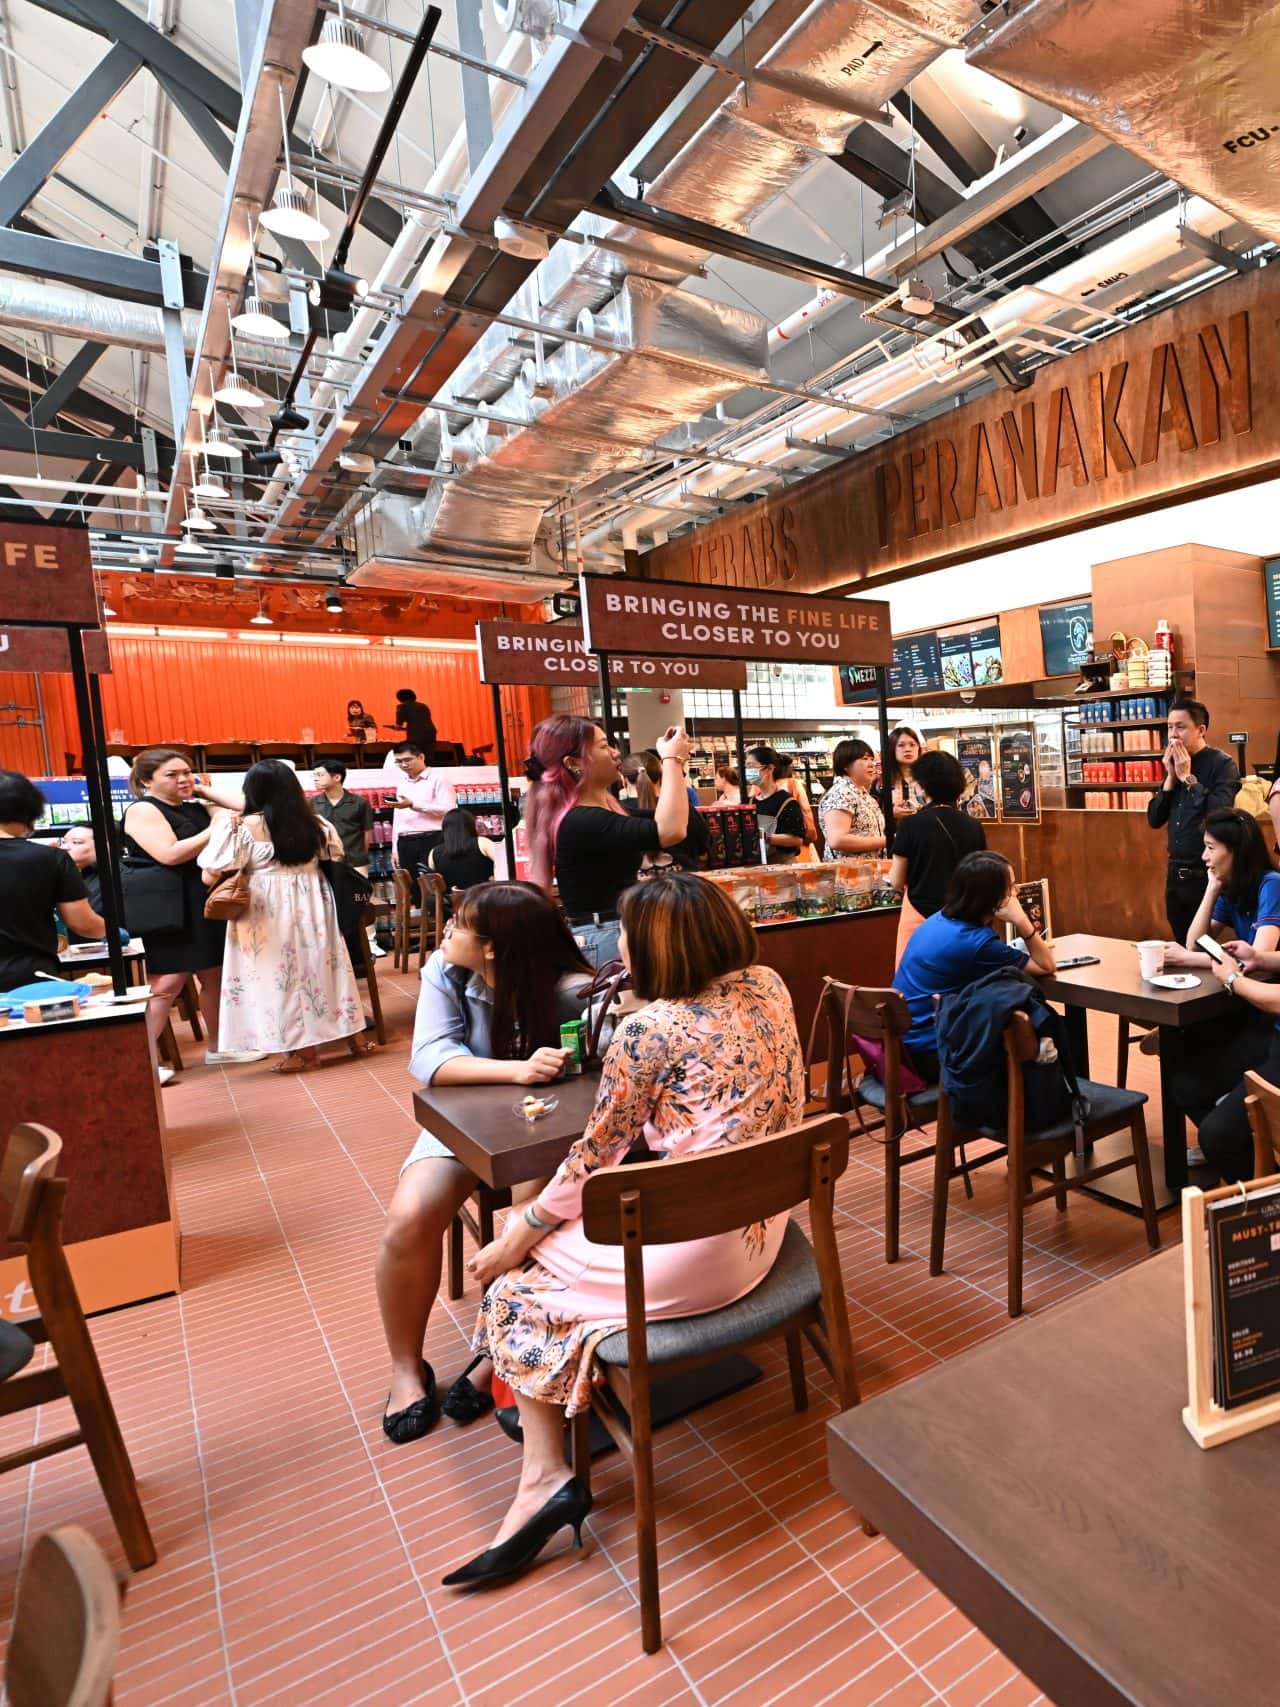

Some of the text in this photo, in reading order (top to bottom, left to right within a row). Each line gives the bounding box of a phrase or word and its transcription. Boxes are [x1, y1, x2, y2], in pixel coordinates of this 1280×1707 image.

[840, 58, 865, 76] PAD
[875, 311, 1253, 549] PERANAKAN
[606, 593, 879, 631] BRINGING THE FINE LIFE
[497, 636, 587, 653] BRINGIN
[661, 622, 840, 649] CLOSER TO YOU
[630, 660, 656, 674] TO
[661, 662, 700, 676] YOU
